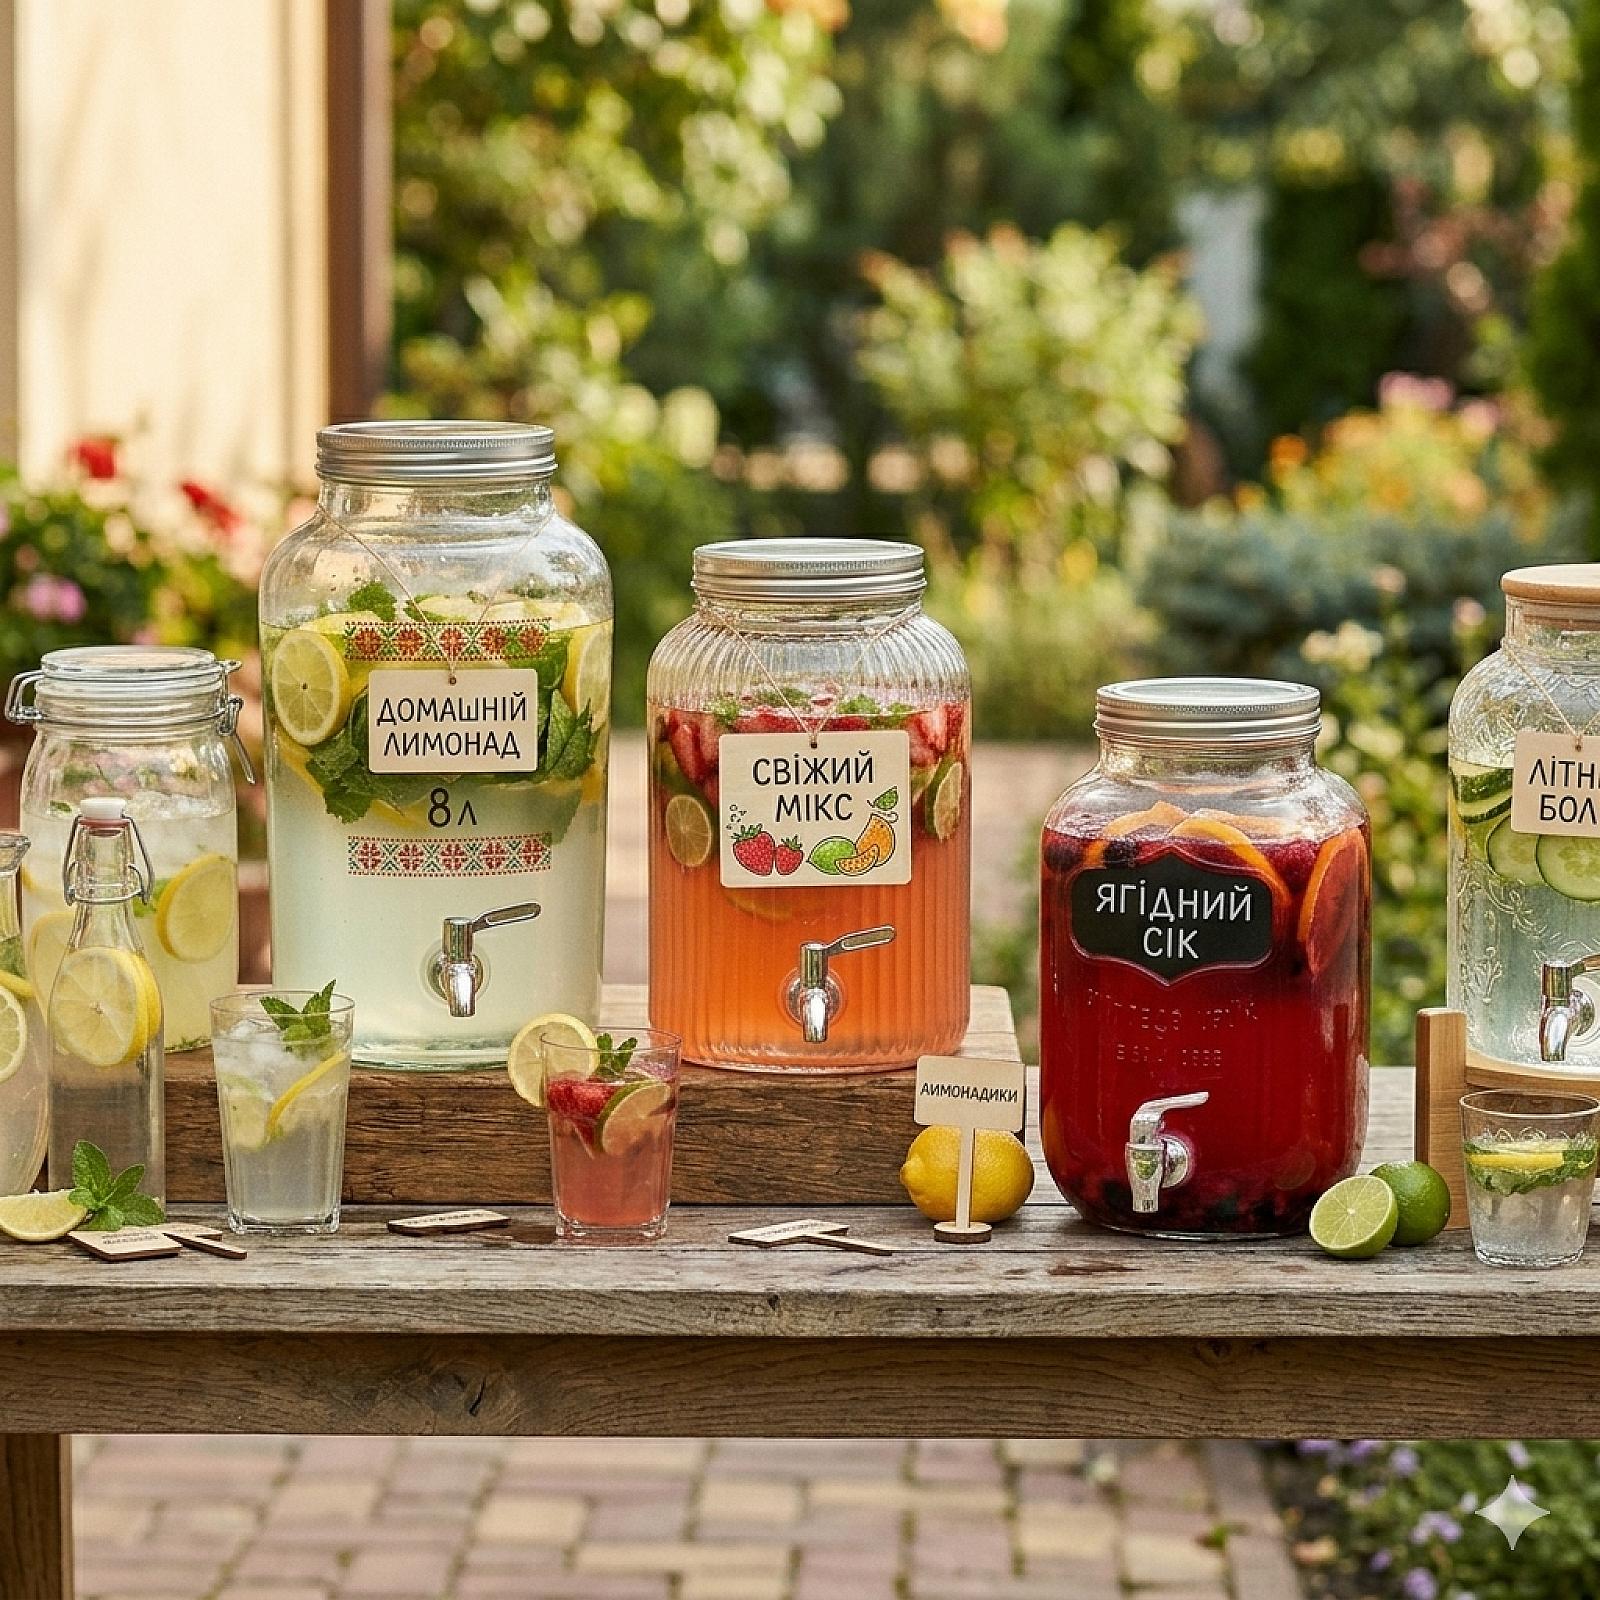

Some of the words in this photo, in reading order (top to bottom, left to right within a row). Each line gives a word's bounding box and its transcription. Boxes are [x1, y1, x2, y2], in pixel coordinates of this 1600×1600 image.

[376, 691, 527, 726] ДОМАШНІЙ
[383, 730, 521, 760] ЛИМОНАД
[427, 787, 451, 828] 8
[775, 793, 853, 823] МІКС
[1143, 927, 1199, 959] СІК
